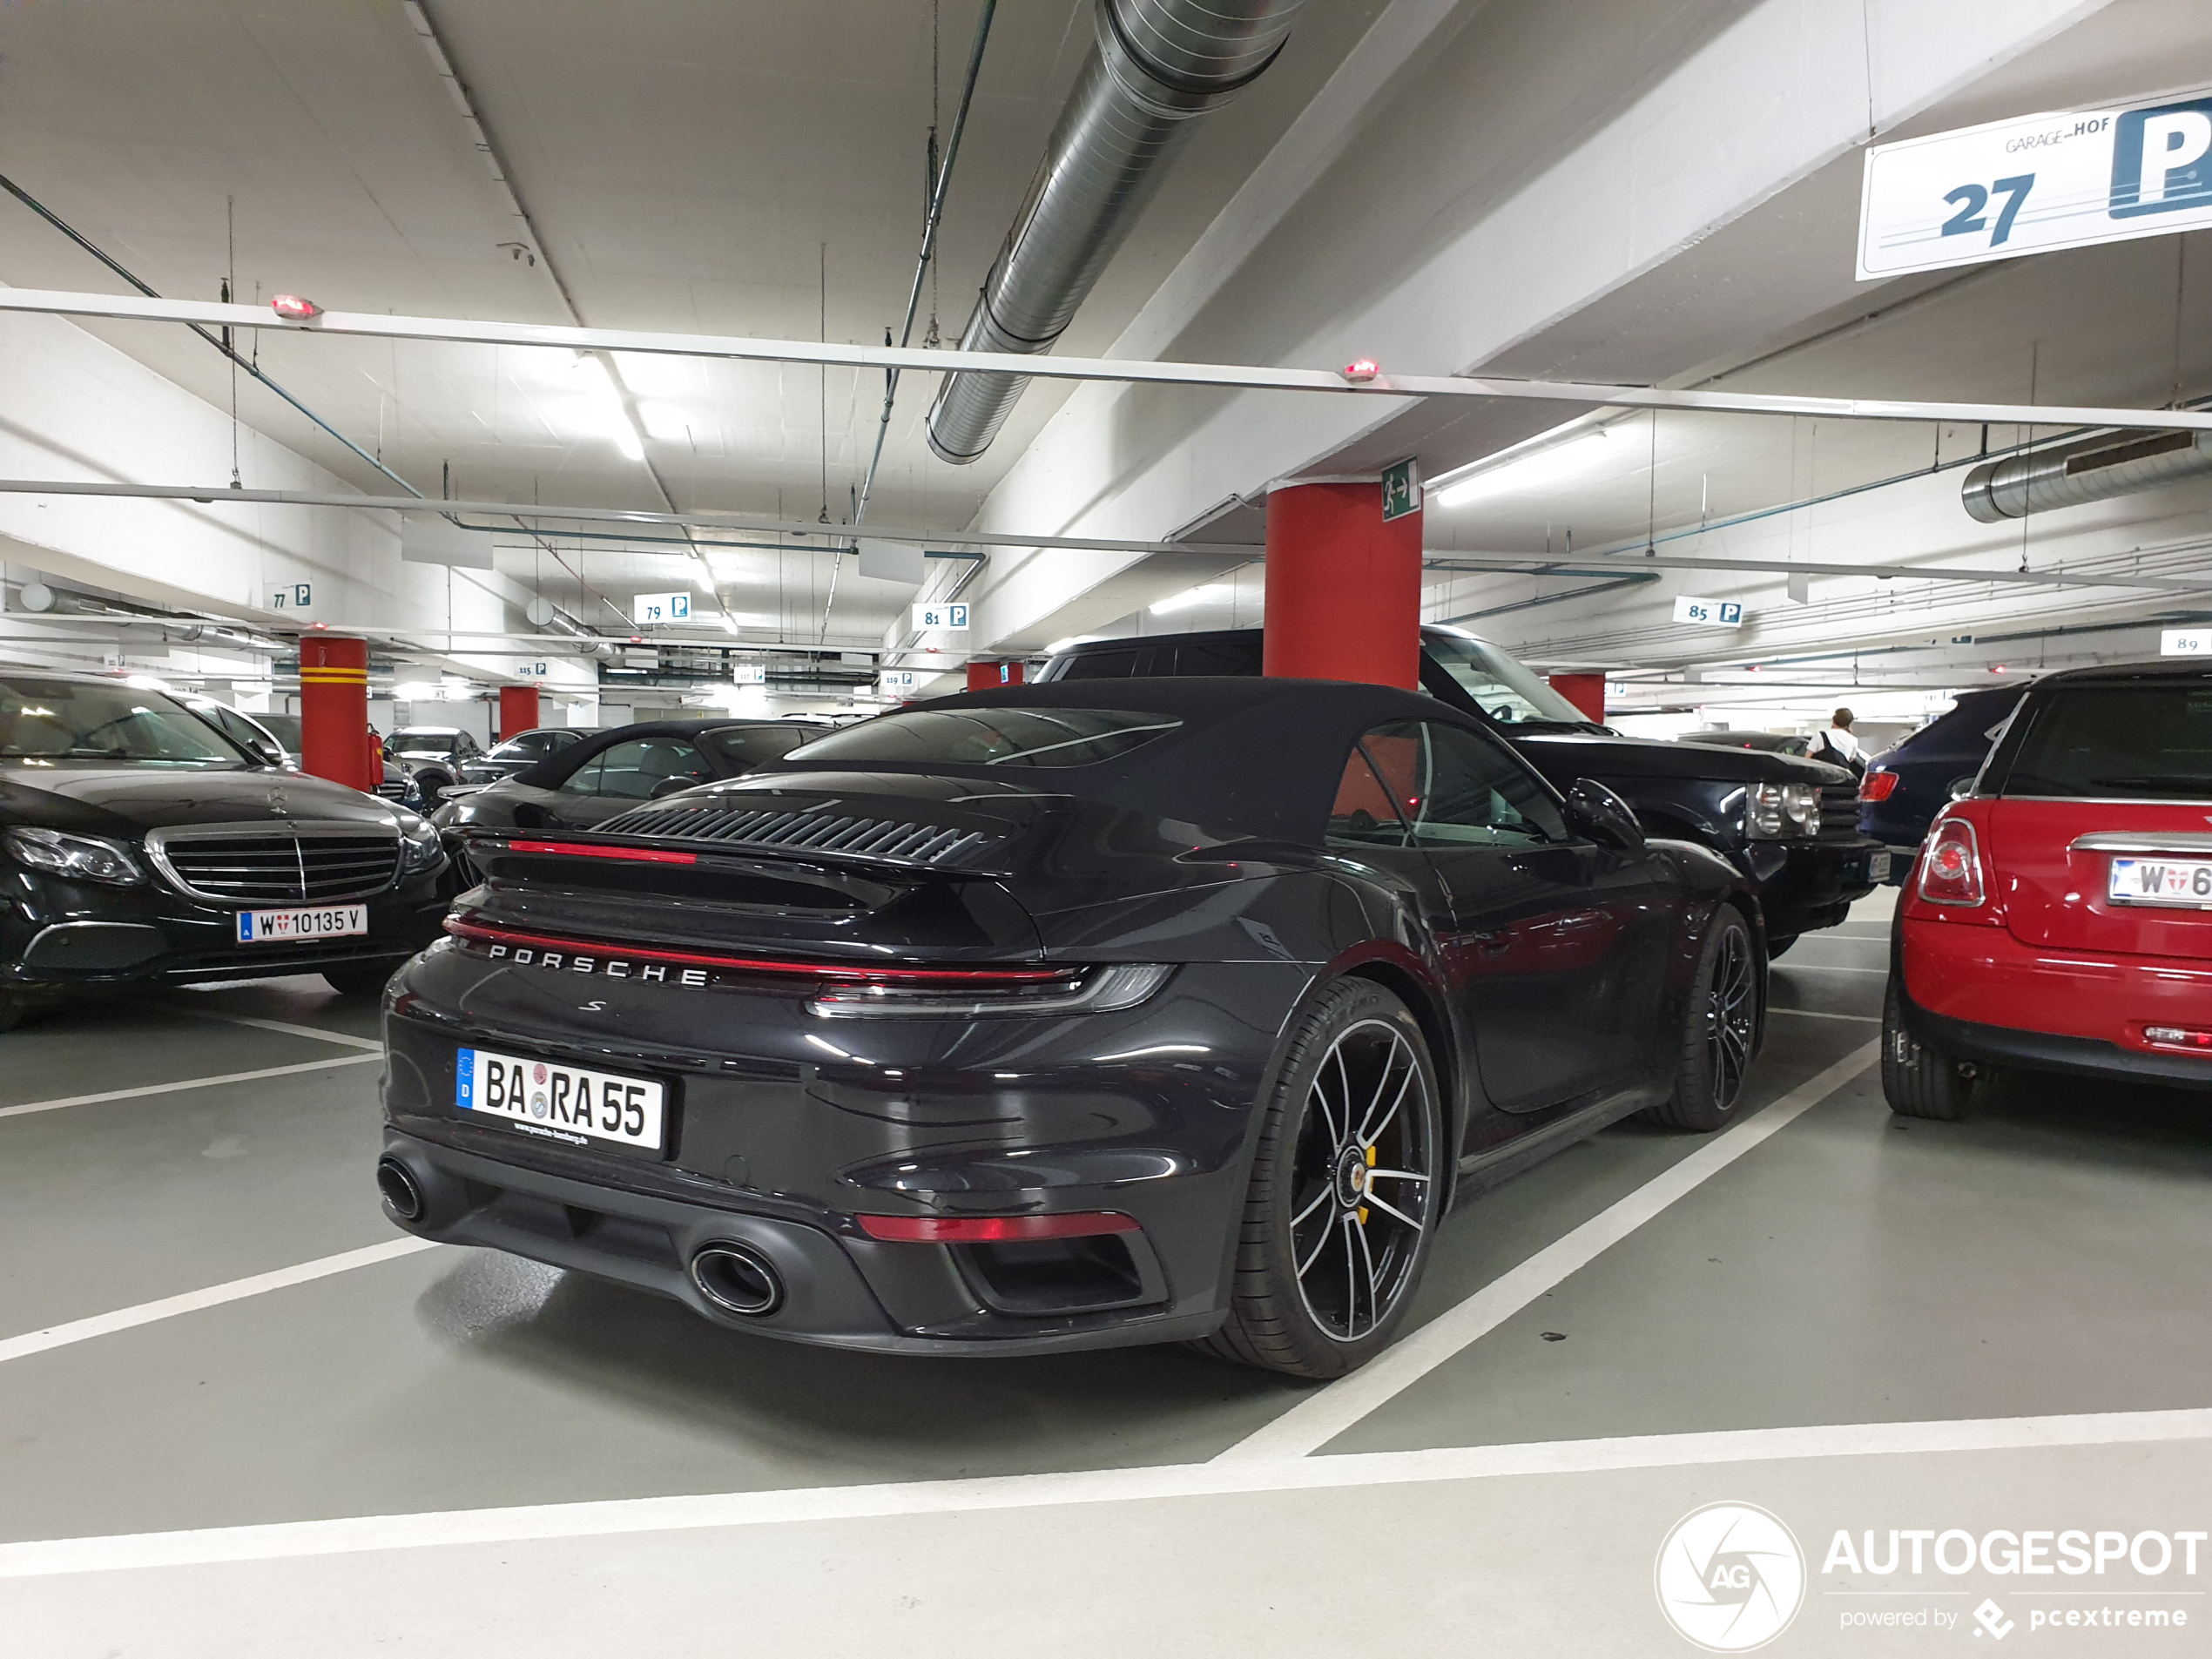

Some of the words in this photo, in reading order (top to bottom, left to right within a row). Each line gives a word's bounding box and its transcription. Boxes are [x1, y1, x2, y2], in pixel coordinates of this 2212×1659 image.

[1941, 172, 2036, 248] 27
[273, 593, 286, 609] 77
[647, 606, 661, 620] 79
[925, 611, 940, 624] 81
[1689, 605, 1708, 621] 85
[2177, 637, 2198, 651] 89
[2141, 865, 2165, 894] W
[260, 915, 274, 935] W
[293, 911, 344, 934] 10135
[349, 910, 359, 929] V
[489, 945, 707, 986] PORSCHE
[577, 1001, 607, 1011] S
[462, 1084, 469, 1097] D
[486, 1059, 526, 1114] BA
